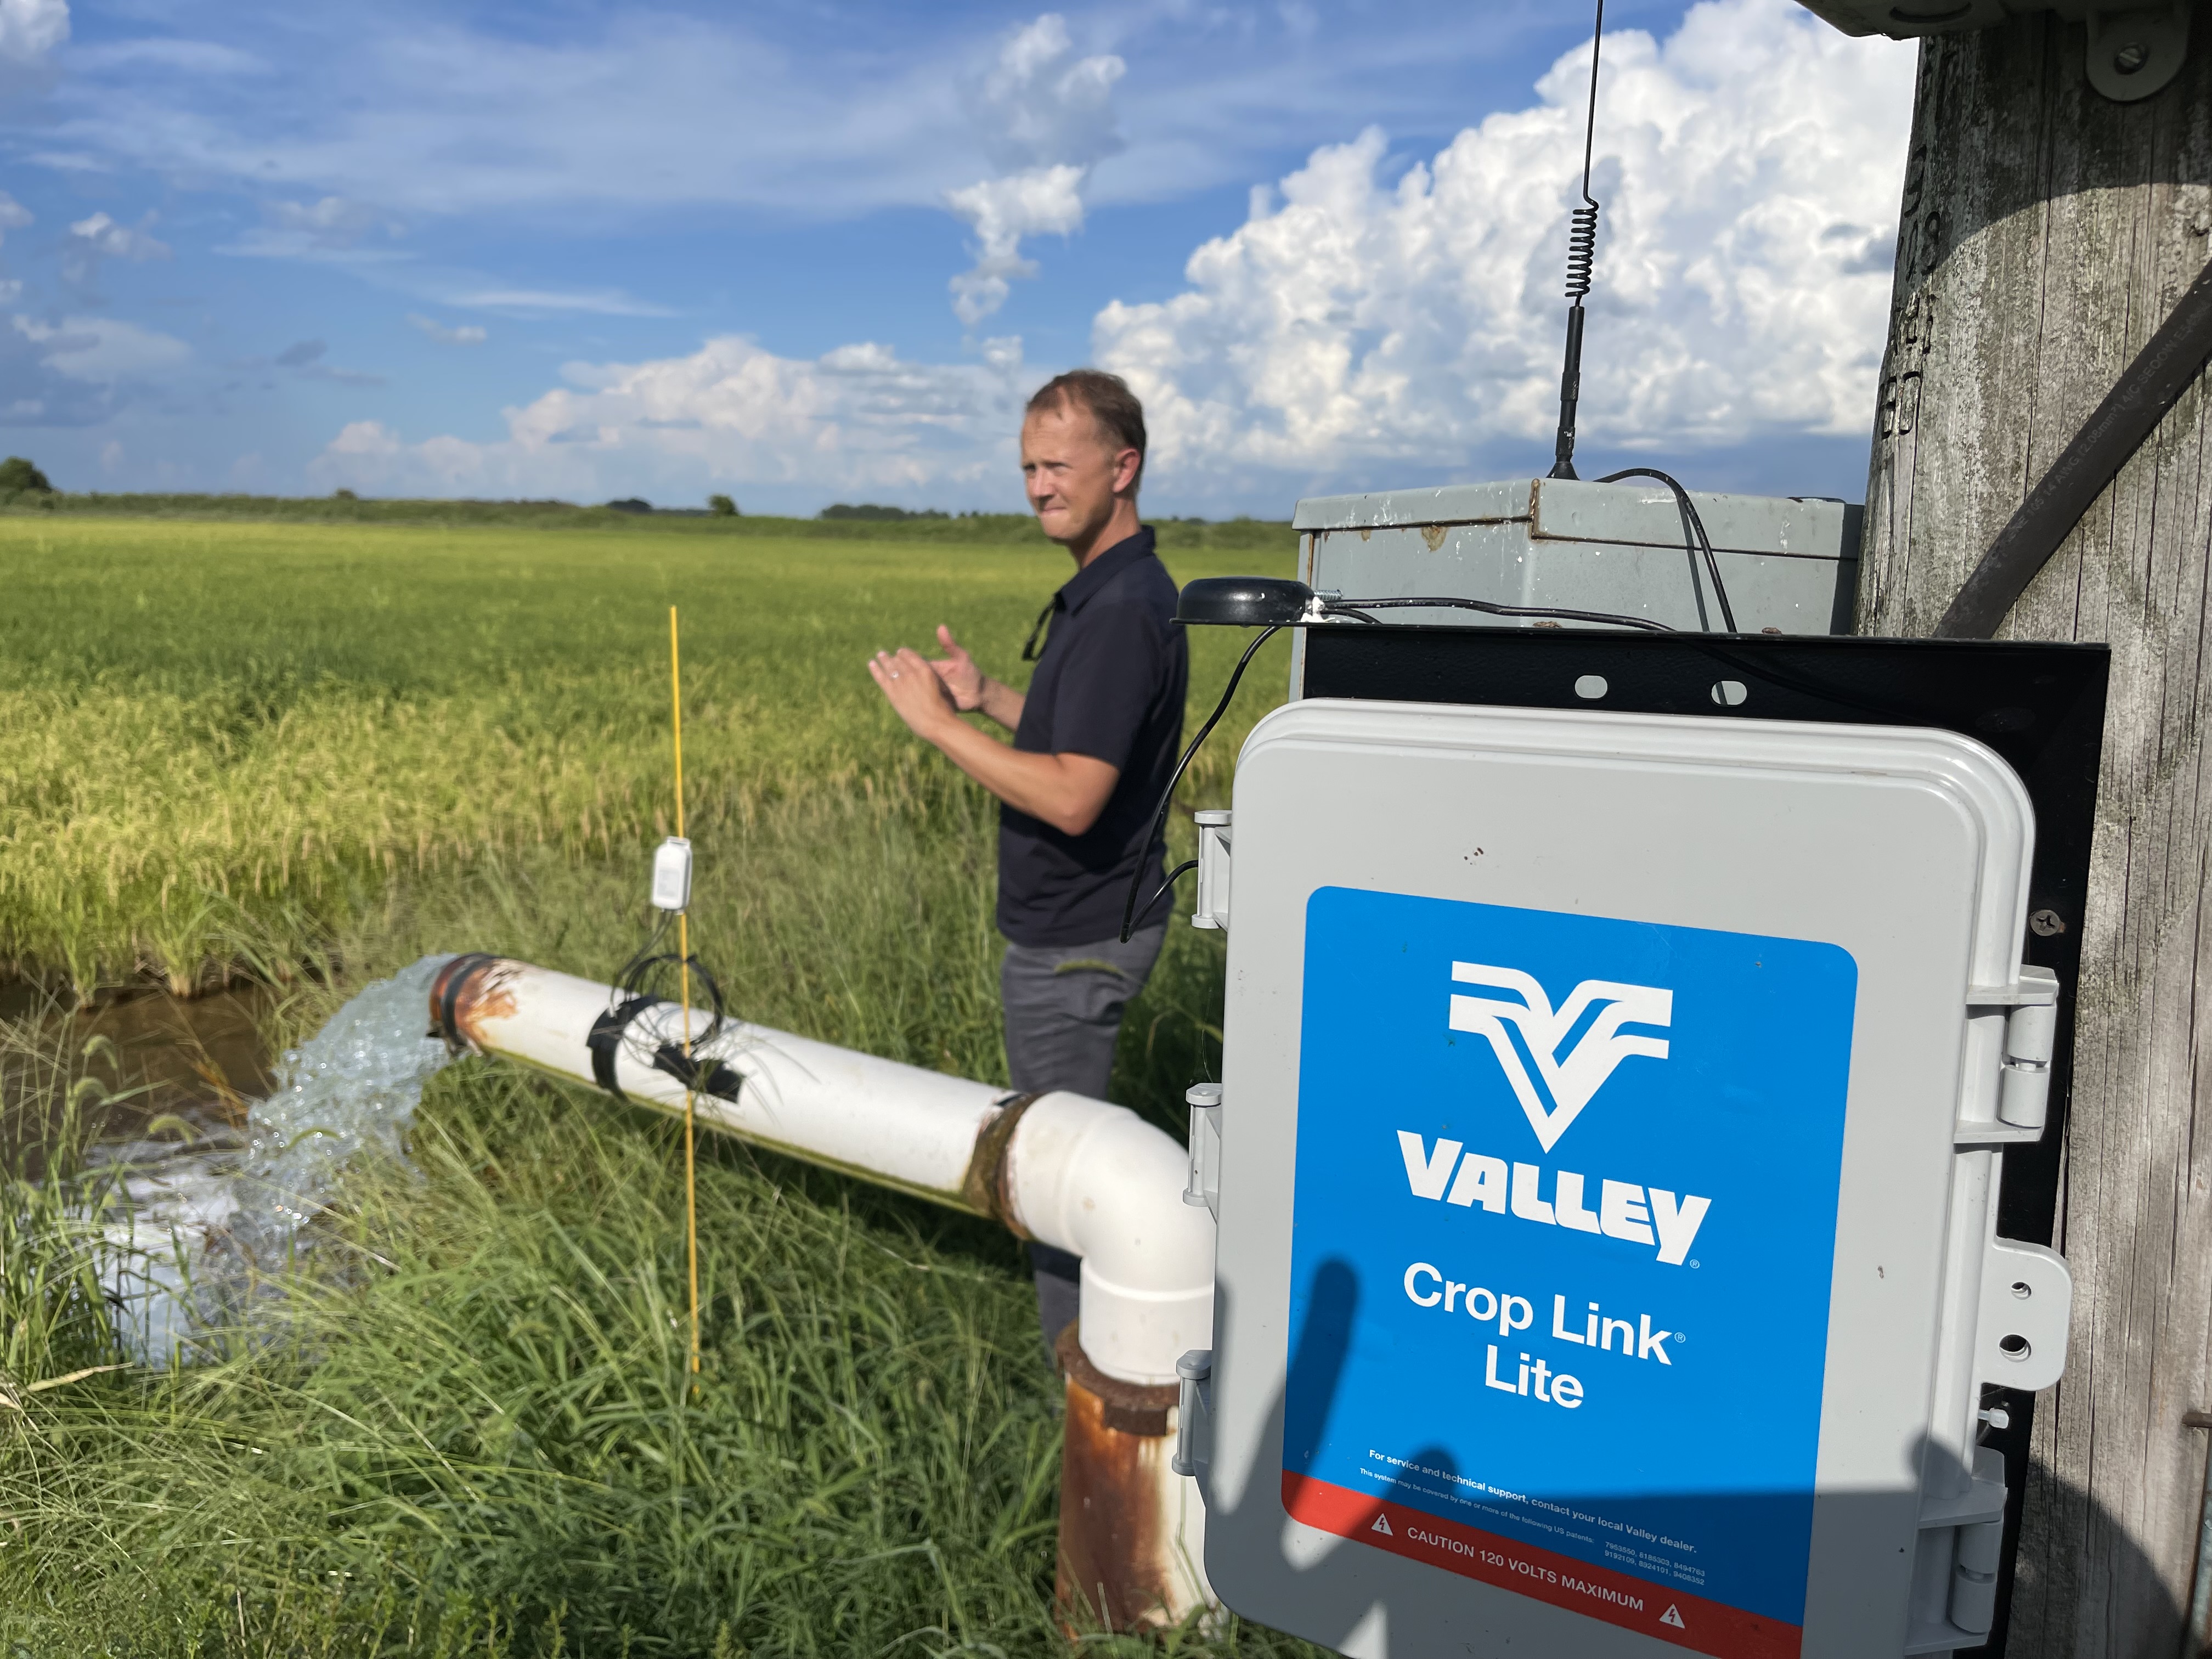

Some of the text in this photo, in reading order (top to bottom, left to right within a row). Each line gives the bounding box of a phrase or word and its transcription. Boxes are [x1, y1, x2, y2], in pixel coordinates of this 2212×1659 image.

[1404, 1262, 1533, 1337] Crop
[1485, 1344, 1584, 1409] Lite
[1360, 1468, 1373, 1477] This
[1374, 1472, 1396, 1484] system
[1398, 1480, 1412, 1489] may
[1423, 1488, 1448, 1499] covered
[1450, 1495, 1458, 1503] by
[1482, 1505, 1499, 1515] more
[1509, 1513, 1520, 1521] the
[1522, 1516, 1553, 1532] following
[1554, 1526, 1565, 1534] US
[1369, 1449, 1697, 1553] For service and technical support, contact your local Valley dealer.
[1407, 1527, 1644, 1611] CAUTION 120 VOLTS MAXIMUM
